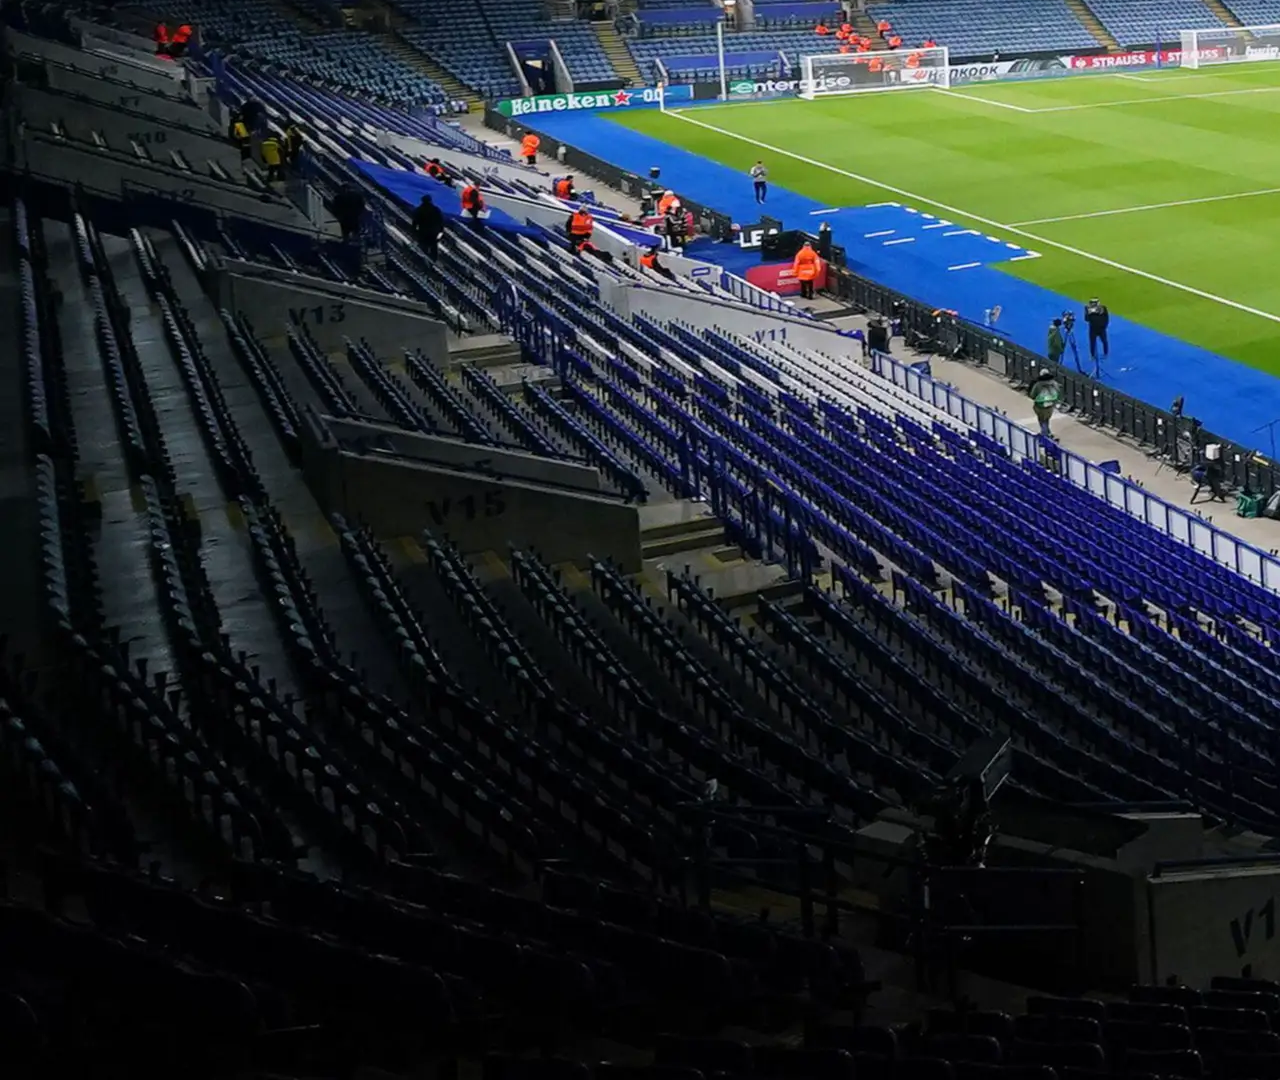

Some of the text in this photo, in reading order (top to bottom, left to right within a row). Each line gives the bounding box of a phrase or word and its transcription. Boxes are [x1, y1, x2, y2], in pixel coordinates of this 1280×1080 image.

[1092, 54, 1146, 68] STRAUSS
[511, 93, 610, 116] Heineken
[288, 305, 346, 326] V13
[755, 327, 786, 344] V11
[425, 490, 506, 525] V15
